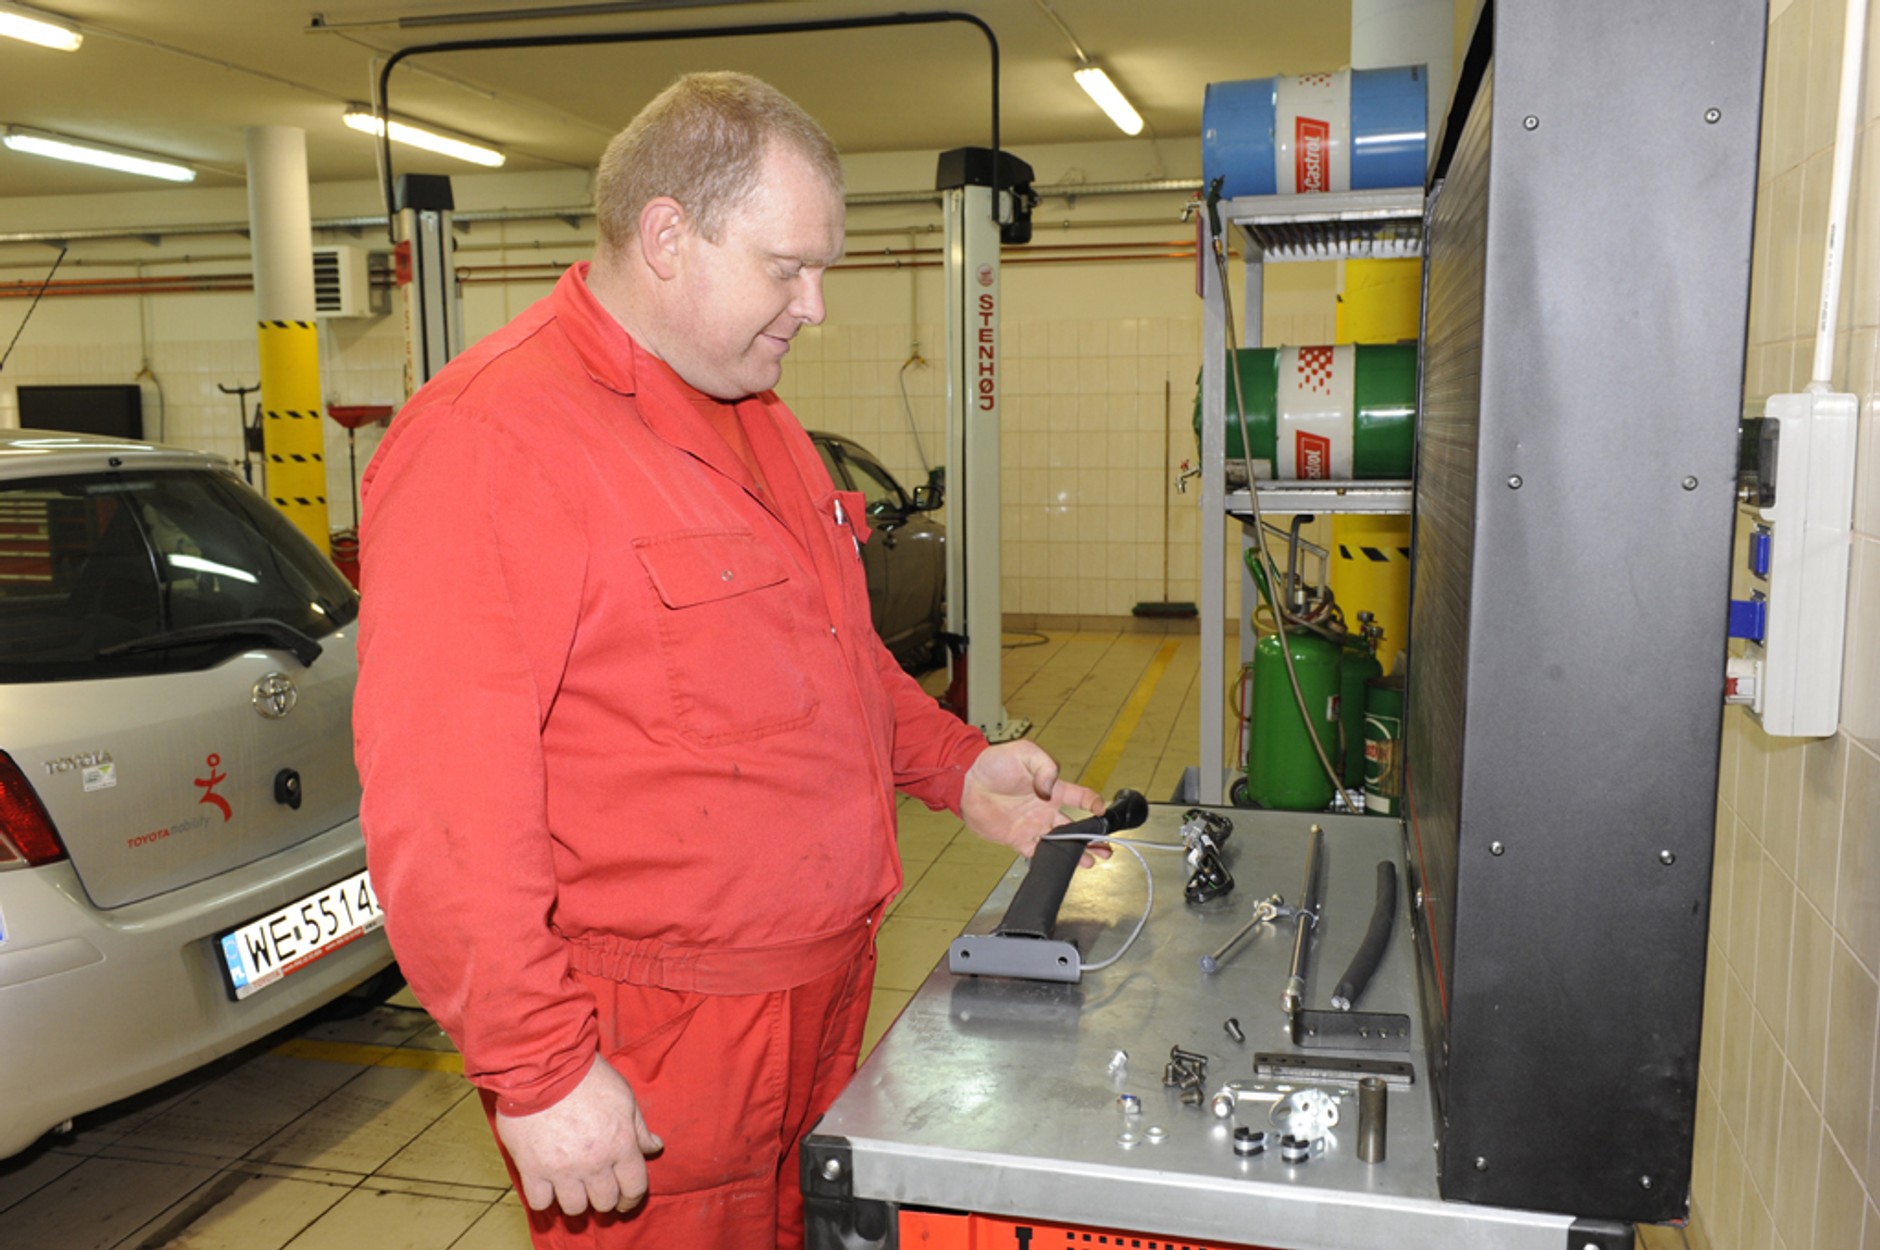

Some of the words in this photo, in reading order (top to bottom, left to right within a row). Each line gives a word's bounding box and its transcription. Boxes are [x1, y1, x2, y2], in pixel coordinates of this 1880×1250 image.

[1303, 135, 1321, 188] Castrol
[978, 294, 995, 411] STENHØJ
[1304, 449, 1321, 480] strol
[43, 750, 113, 775] TOYOTA
[127, 828, 170, 848] TOYOTA
[300, 879, 381, 945] 5514
